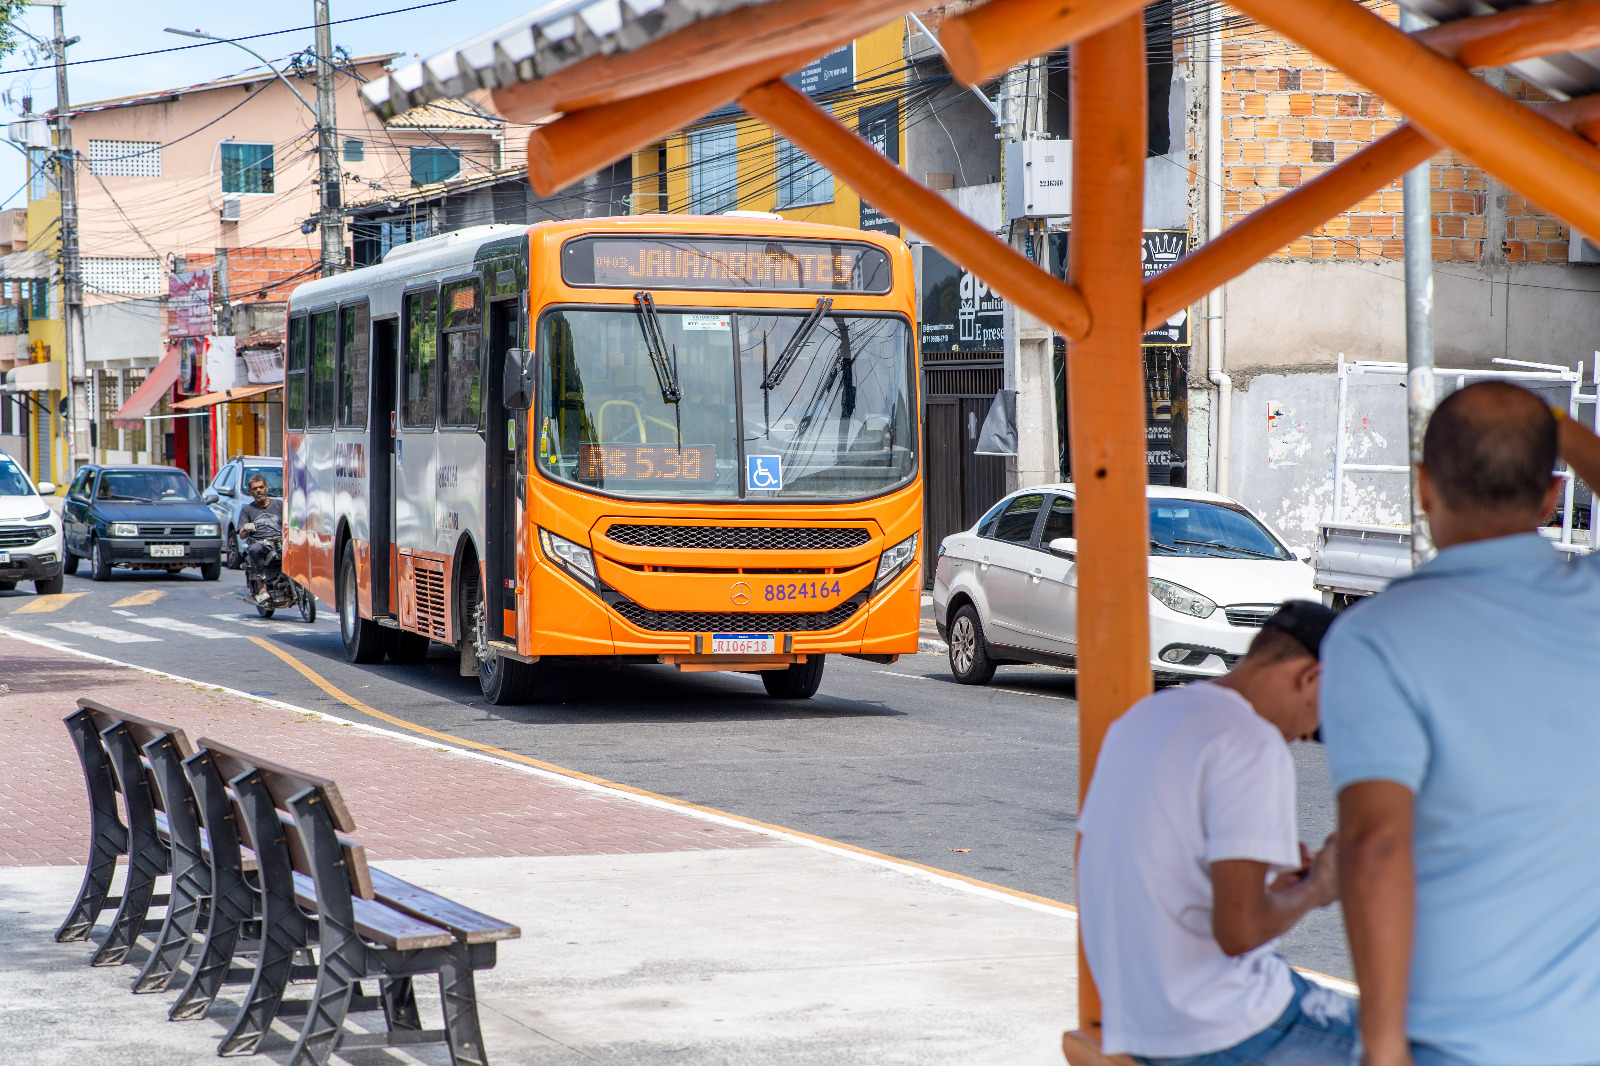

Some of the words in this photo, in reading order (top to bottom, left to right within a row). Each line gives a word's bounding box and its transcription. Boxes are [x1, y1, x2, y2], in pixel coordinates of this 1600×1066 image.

[596, 256, 628, 268] 0403
[589, 447, 627, 478] R$
[438, 465, 458, 488] 8824164
[764, 581, 841, 601] 8824164
